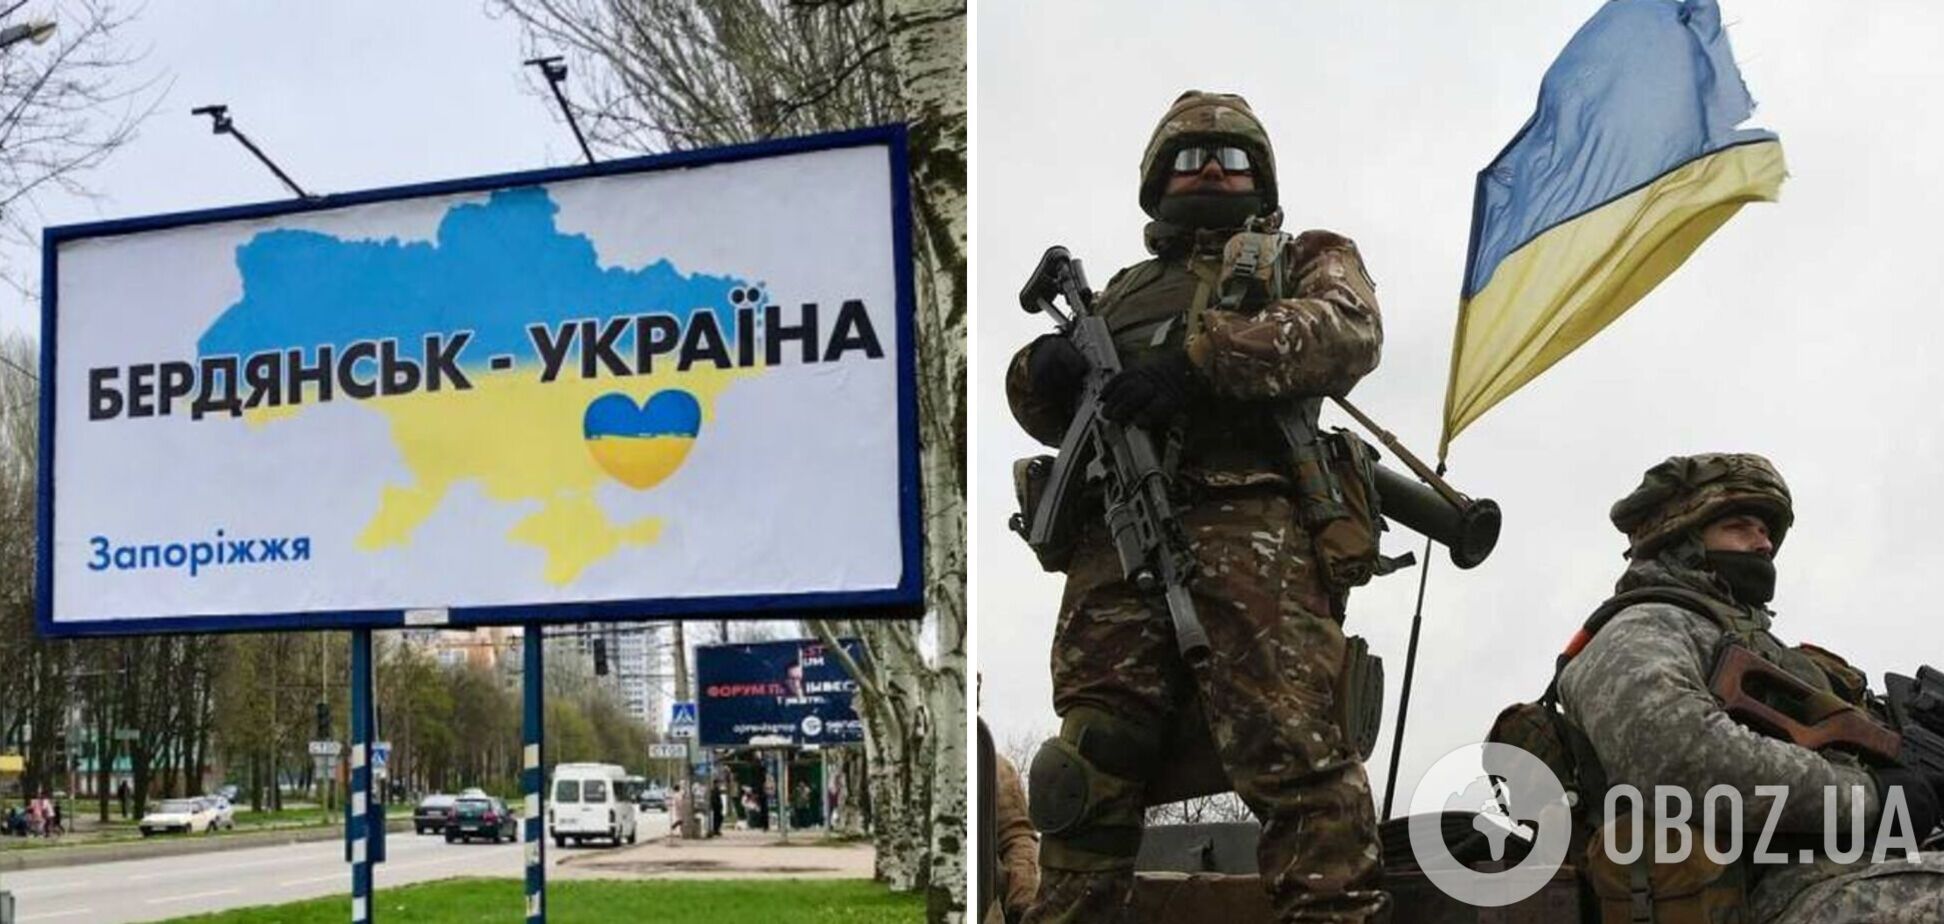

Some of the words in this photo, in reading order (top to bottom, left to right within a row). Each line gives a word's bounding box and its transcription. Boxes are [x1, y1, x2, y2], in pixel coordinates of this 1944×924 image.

[87, 332, 474, 421] БЕРДЯНСЬК
[490, 355, 512, 370] -
[528, 287, 885, 383] УКРАЇНА
[87, 529, 312, 576] Запоріжжя
[707, 684, 765, 698] ФОРУМ
